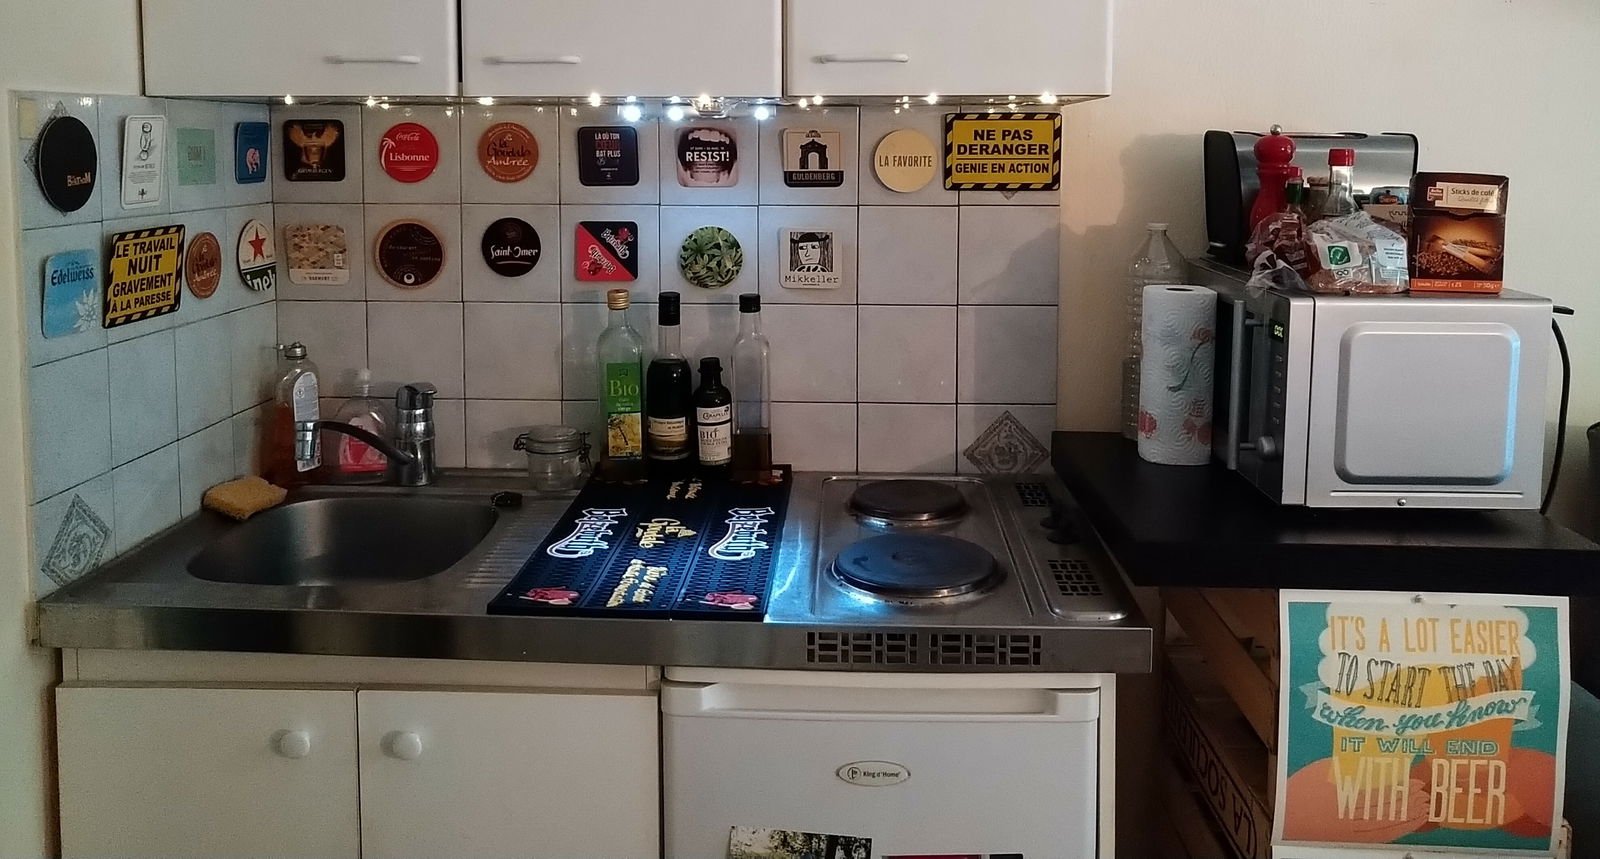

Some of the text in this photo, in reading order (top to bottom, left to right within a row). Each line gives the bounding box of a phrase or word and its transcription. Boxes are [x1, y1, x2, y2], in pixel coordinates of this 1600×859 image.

[973, 129, 1033, 141] NE PAS
[389, 152, 430, 161] Lisbonne
[607, 150, 621, 158] PLUS
[685, 151, 730, 162] RESIST!
[956, 144, 1049, 156] DERANGER
[879, 155, 933, 168] LA FAVORITE
[955, 162, 1049, 174] GENIE EN ACTION
[1451, 187, 1470, 195] Sticks
[1471, 188, 1480, 196] de
[1480, 189, 1495, 197] café
[115, 237, 175, 259] LE TRAVAIL
[127, 254, 162, 276] NUIT
[50, 267, 96, 287] Edelweiss
[112, 272, 174, 298] GRAVEMENT
[784, 275, 839, 284] Mikkeller
[120, 298, 132, 311] LA
[134, 290, 172, 309] PARESSE
[1329, 616, 1521, 656] IT'S A LOT EASIER
[1334, 652, 1519, 708] TO START THE DAY
[1319, 698, 1527, 736] when you know
[1340, 736, 1499, 756] IT WILL END
[1333, 757, 1508, 825] WITH BEER
